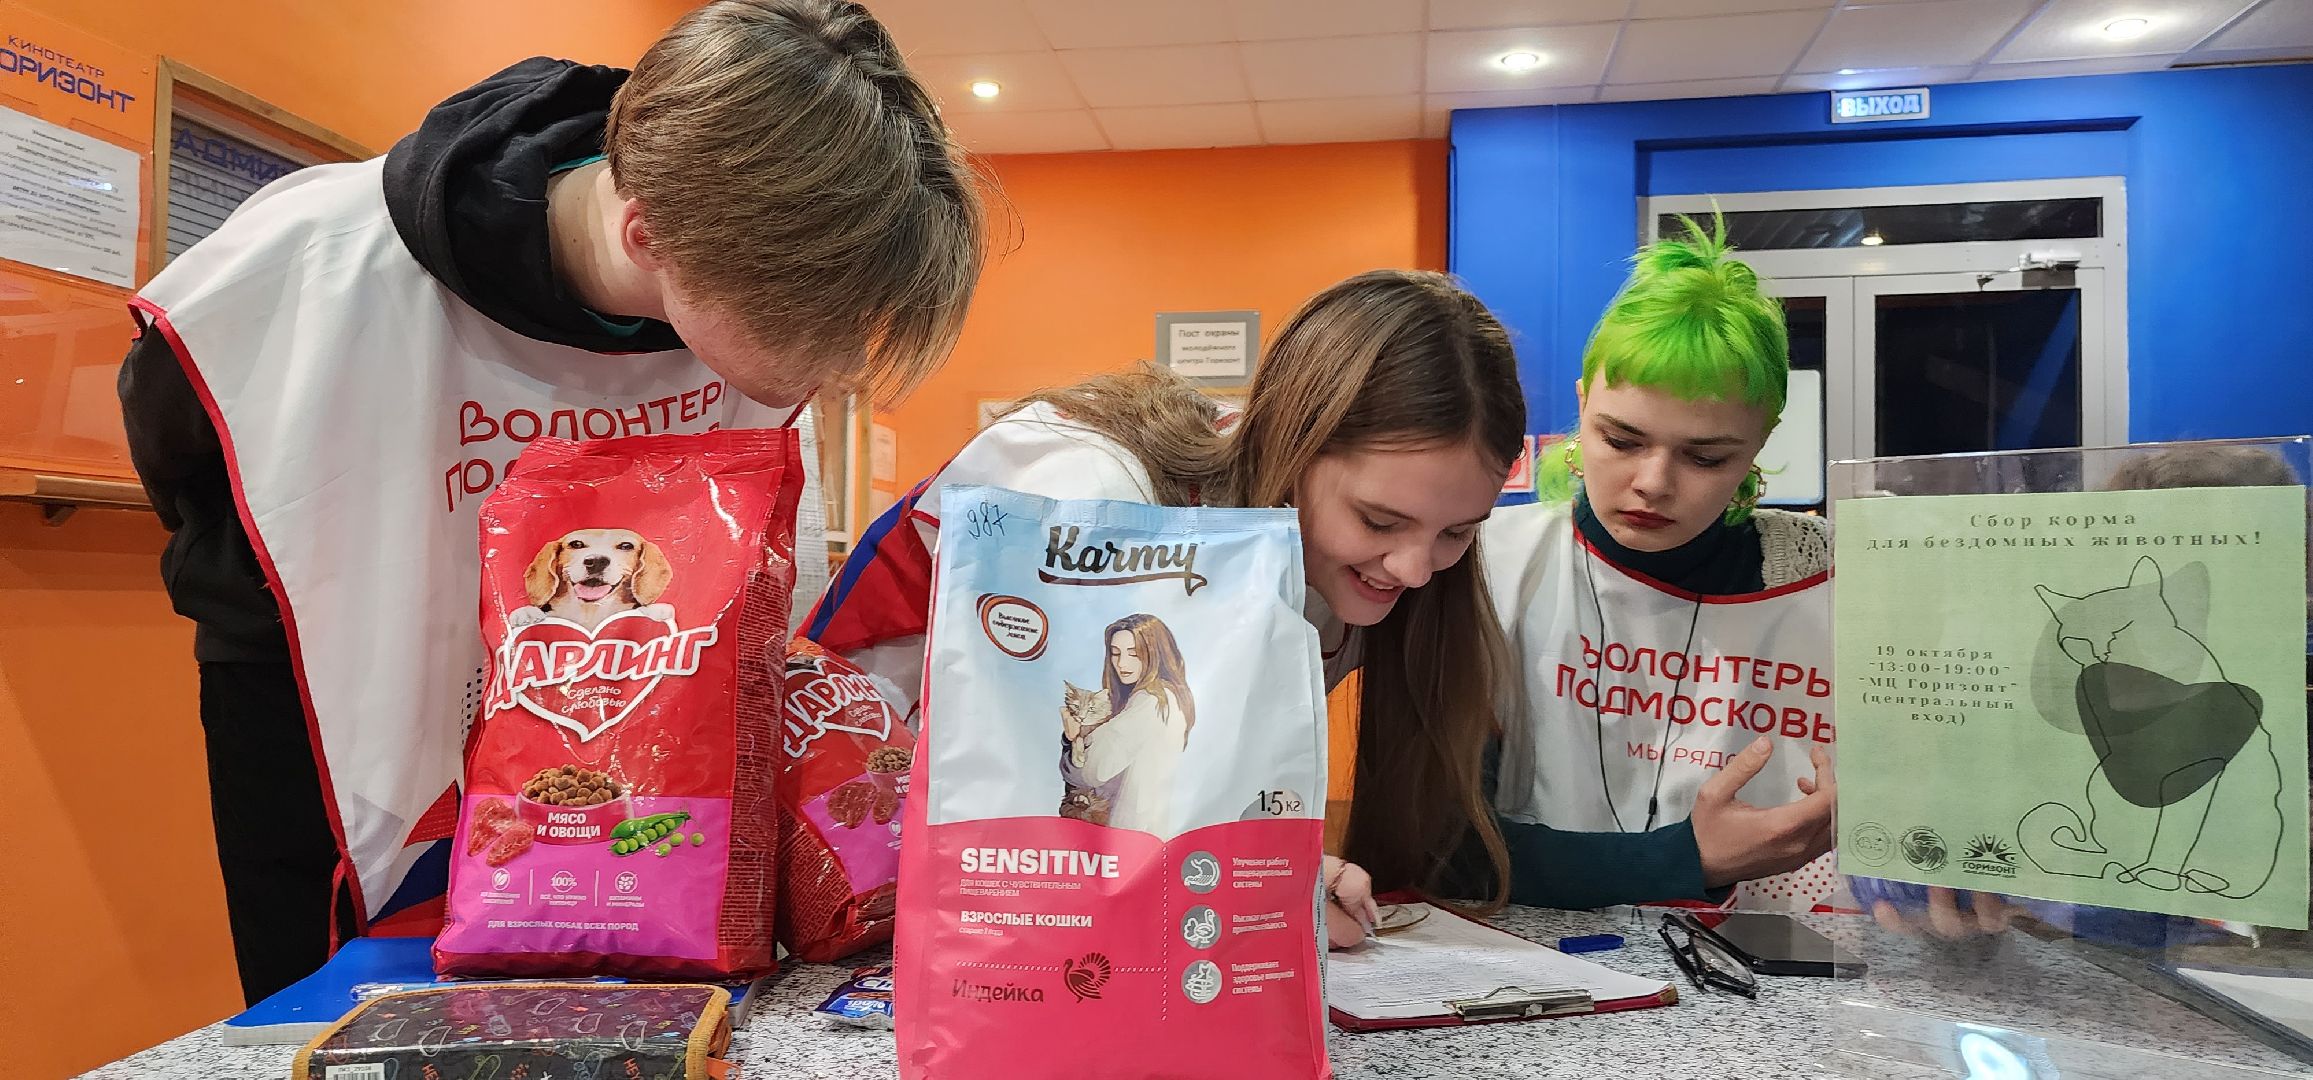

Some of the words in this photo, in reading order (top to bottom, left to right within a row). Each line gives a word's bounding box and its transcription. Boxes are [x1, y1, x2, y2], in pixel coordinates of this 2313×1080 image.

[8, 34, 105, 78] КИНОТЕАТР
[0, 48, 136, 113] ОРИЗОНТ
[1840, 94, 1920, 118] ВЫХОД
[1178, 329, 1200, 338] Пост
[1204, 329, 1240, 338] охраны
[967, 501, 1008, 540] 987
[1970, 513, 2032, 530] Сбор
[2049, 514, 2137, 529] корма
[1866, 538, 1909, 550] для
[1923, 535, 2076, 550] бездомных
[2091, 531, 2261, 547] животных!
[1044, 526, 1207, 597] Karmy
[1876, 645, 1896, 657] 19
[1906, 648, 1993, 662] октября
[483, 628, 719, 722] ДАРЛИНГ
[567, 685, 622, 701] Сделано
[1862, 691, 2015, 710] (центральный
[1911, 711, 1966, 727] вход)
[547, 811, 587, 825] МЯСО
[536, 824, 547, 837] И
[548, 824, 601, 840] ОВОЩИ
[961, 847, 1120, 879] SENSITIVE
[1962, 861, 2017, 875] ГОРИЗОНТ
[550, 876, 578, 888] 100%
[487, 920, 506, 929] ДЛЯ
[507, 920, 554, 929] ВЗРОСЛЫХ
[554, 921, 583, 930] СОБАК
[583, 922, 607, 931] ВСЕХ
[607, 922, 640, 931] ПОРОД
[960, 910, 1034, 926] ВЗРОСЛЫЕ
[1035, 914, 1093, 928] КОШКИ
[952, 978, 1045, 1004] Индейка
